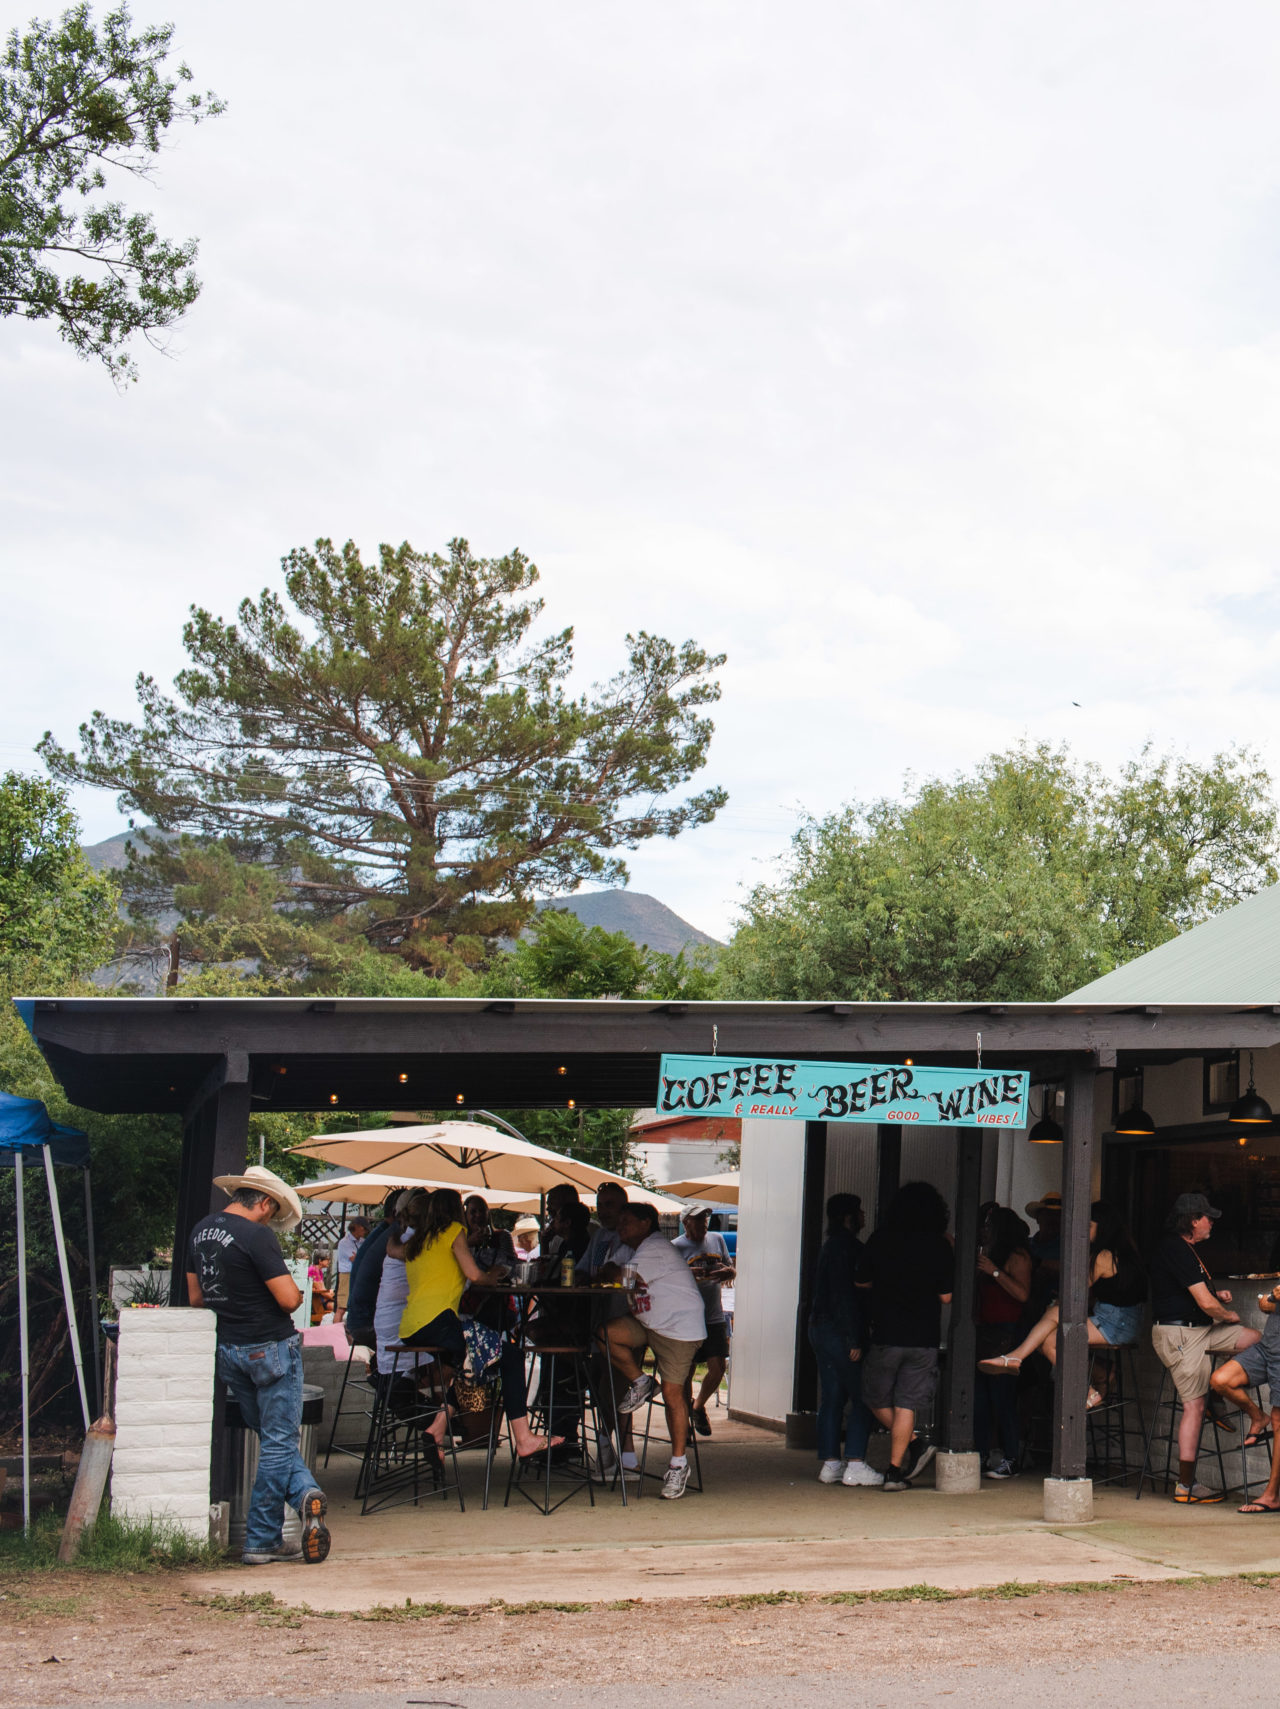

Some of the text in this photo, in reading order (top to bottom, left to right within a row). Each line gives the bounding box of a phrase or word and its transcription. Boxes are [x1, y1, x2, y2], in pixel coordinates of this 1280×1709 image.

[661, 1063, 1023, 1123] COFFEE BEER WINE
[734, 1101, 1017, 1126] & REALLY GOOD VIBES!
[193, 1227, 234, 1248] FREEDOM
